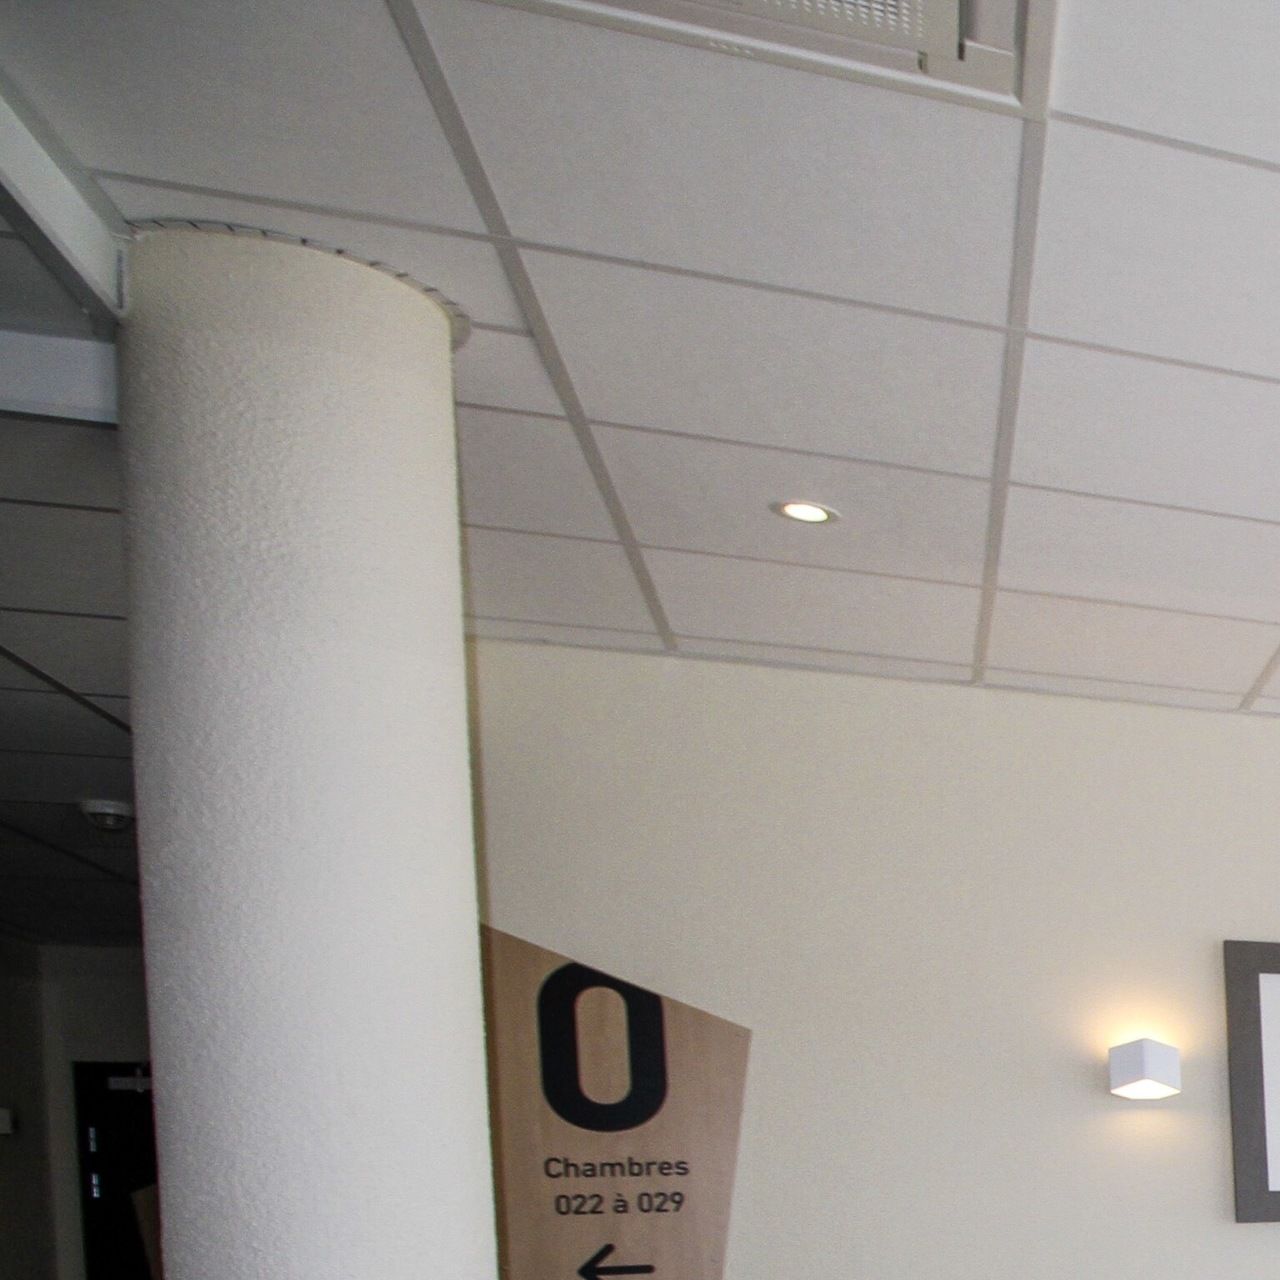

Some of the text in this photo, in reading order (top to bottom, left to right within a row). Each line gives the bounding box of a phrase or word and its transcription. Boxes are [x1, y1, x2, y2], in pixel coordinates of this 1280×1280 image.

[543, 1156, 689, 1179] Chambres
[555, 1191, 685, 1216] 022 à 029
